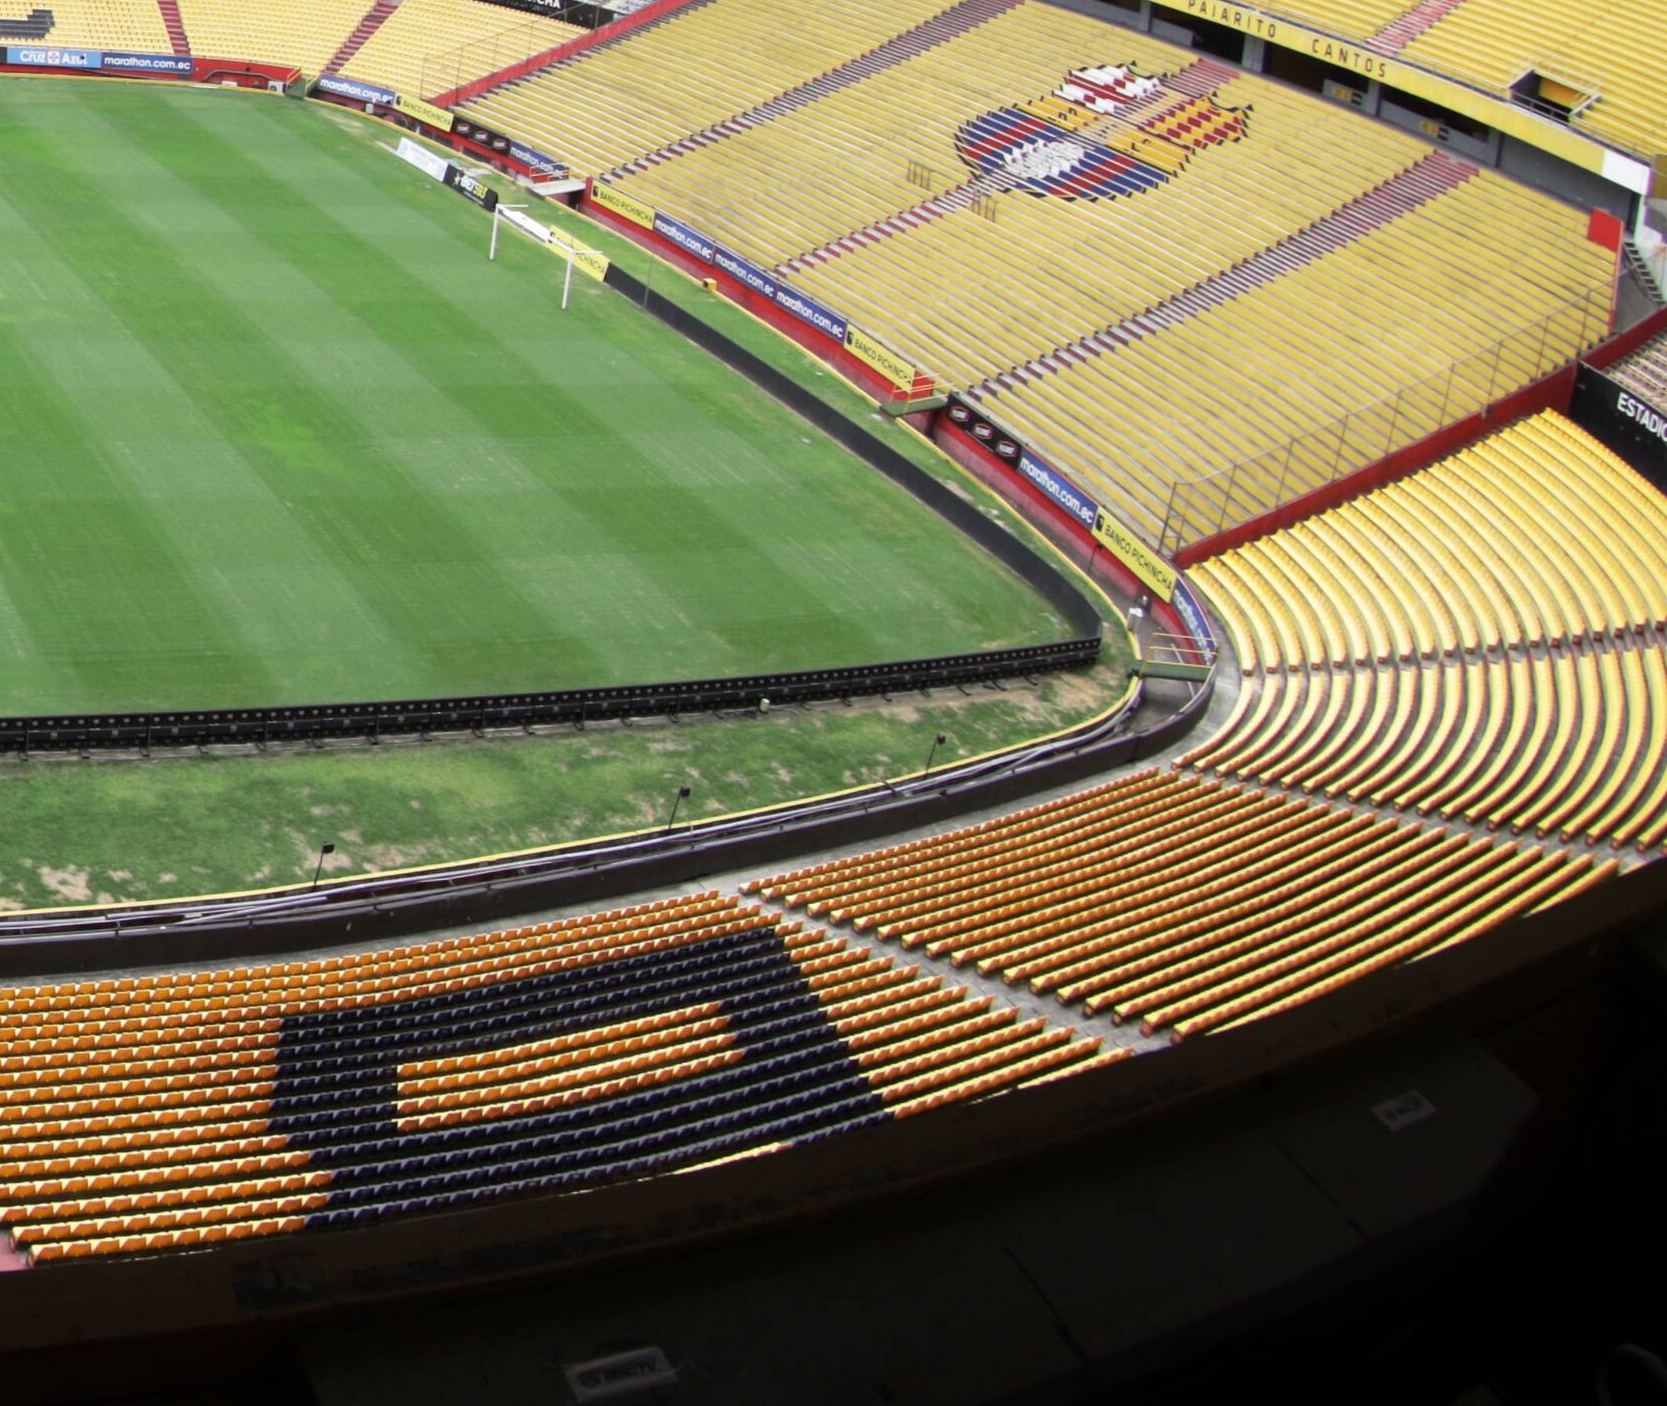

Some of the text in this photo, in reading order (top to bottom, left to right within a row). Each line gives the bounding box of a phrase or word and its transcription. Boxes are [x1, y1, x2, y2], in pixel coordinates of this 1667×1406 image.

[19, 50, 47, 62] Cruz
[104, 55, 191, 70] marathon.com.ec
[1312, 38, 1387, 78] CANTOS
[654, 218, 712, 260] marathon.com.ec
[715, 253, 774, 298] marathon.com.ec
[776, 290, 843, 338] marathon.com.ec
[1020, 455, 1094, 525] marathon.com.ec
[1104, 524, 1173, 592] BANCO PICHINCHA
